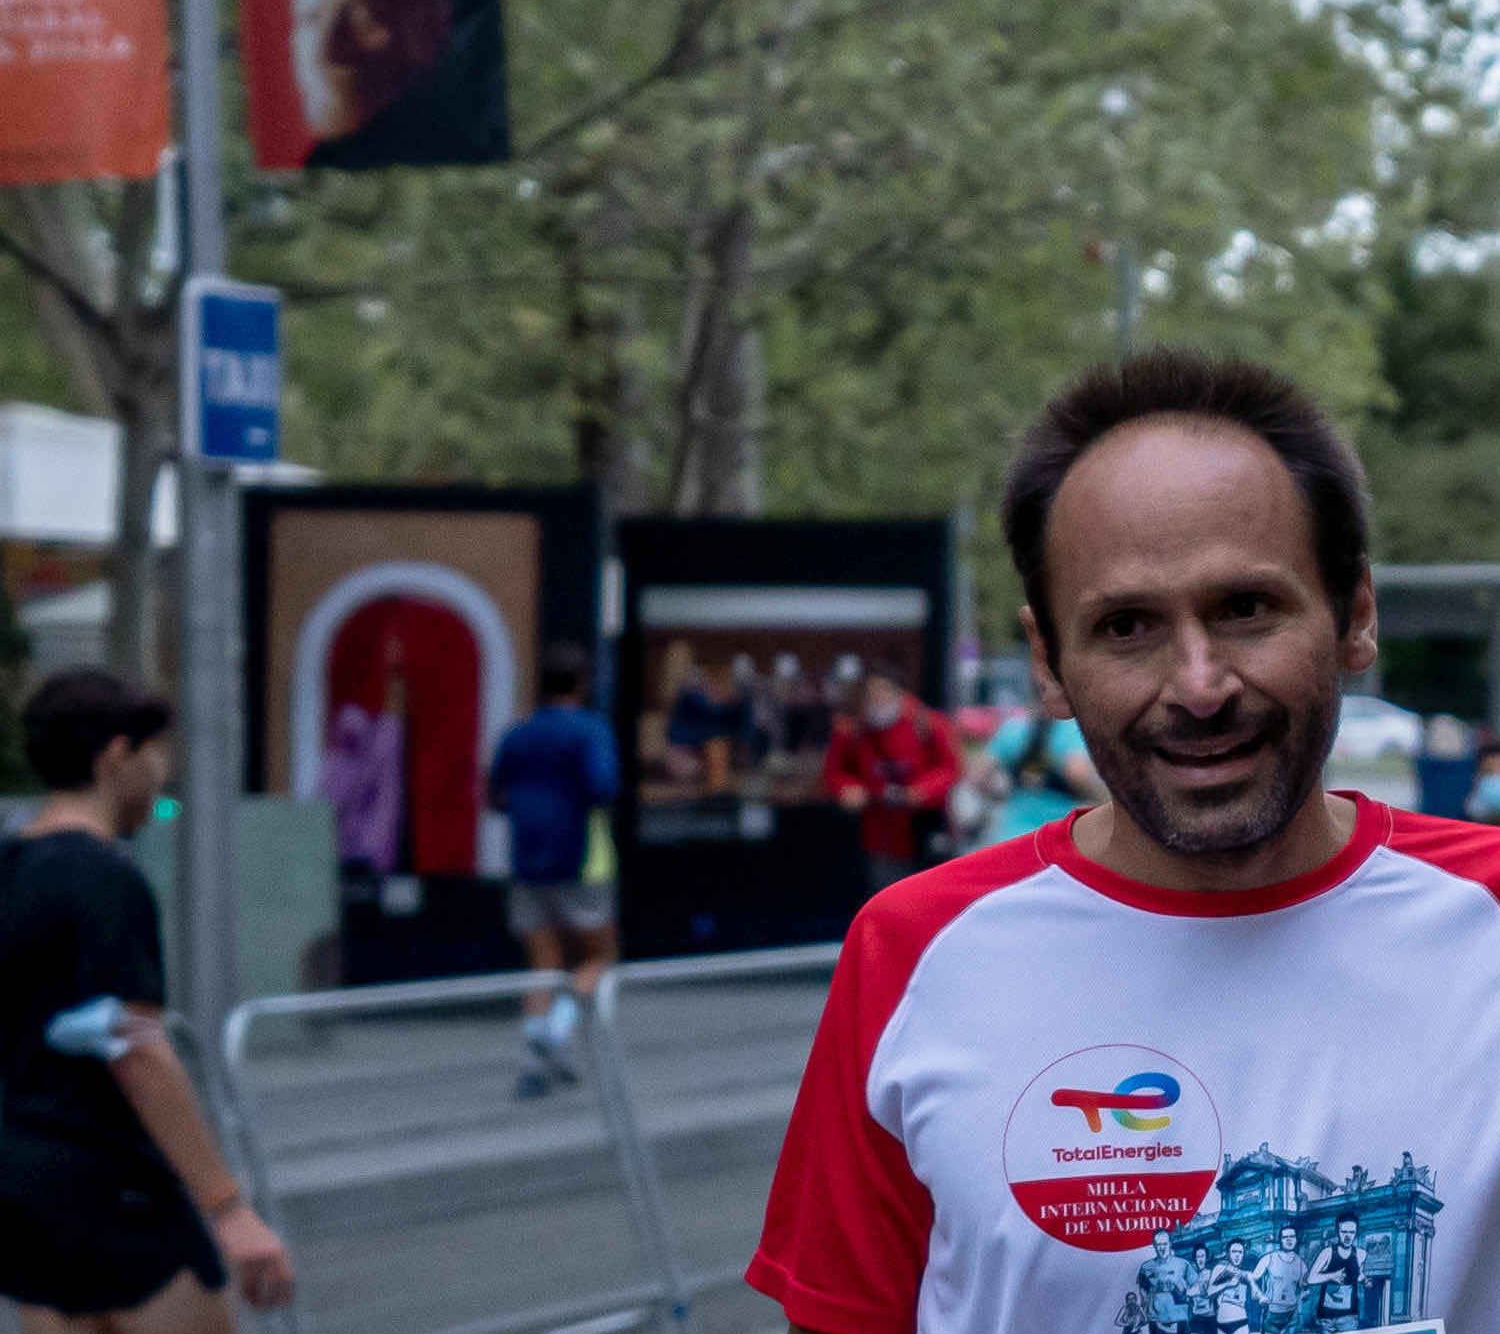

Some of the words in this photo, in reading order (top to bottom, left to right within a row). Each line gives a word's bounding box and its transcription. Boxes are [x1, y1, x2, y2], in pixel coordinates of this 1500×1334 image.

[1052, 1142, 1183, 1163] TotalEnergies
[1086, 1180, 1147, 1197] MILLA
[1065, 1220, 1090, 1236] DE
[1096, 1215, 1171, 1233] MADRID
